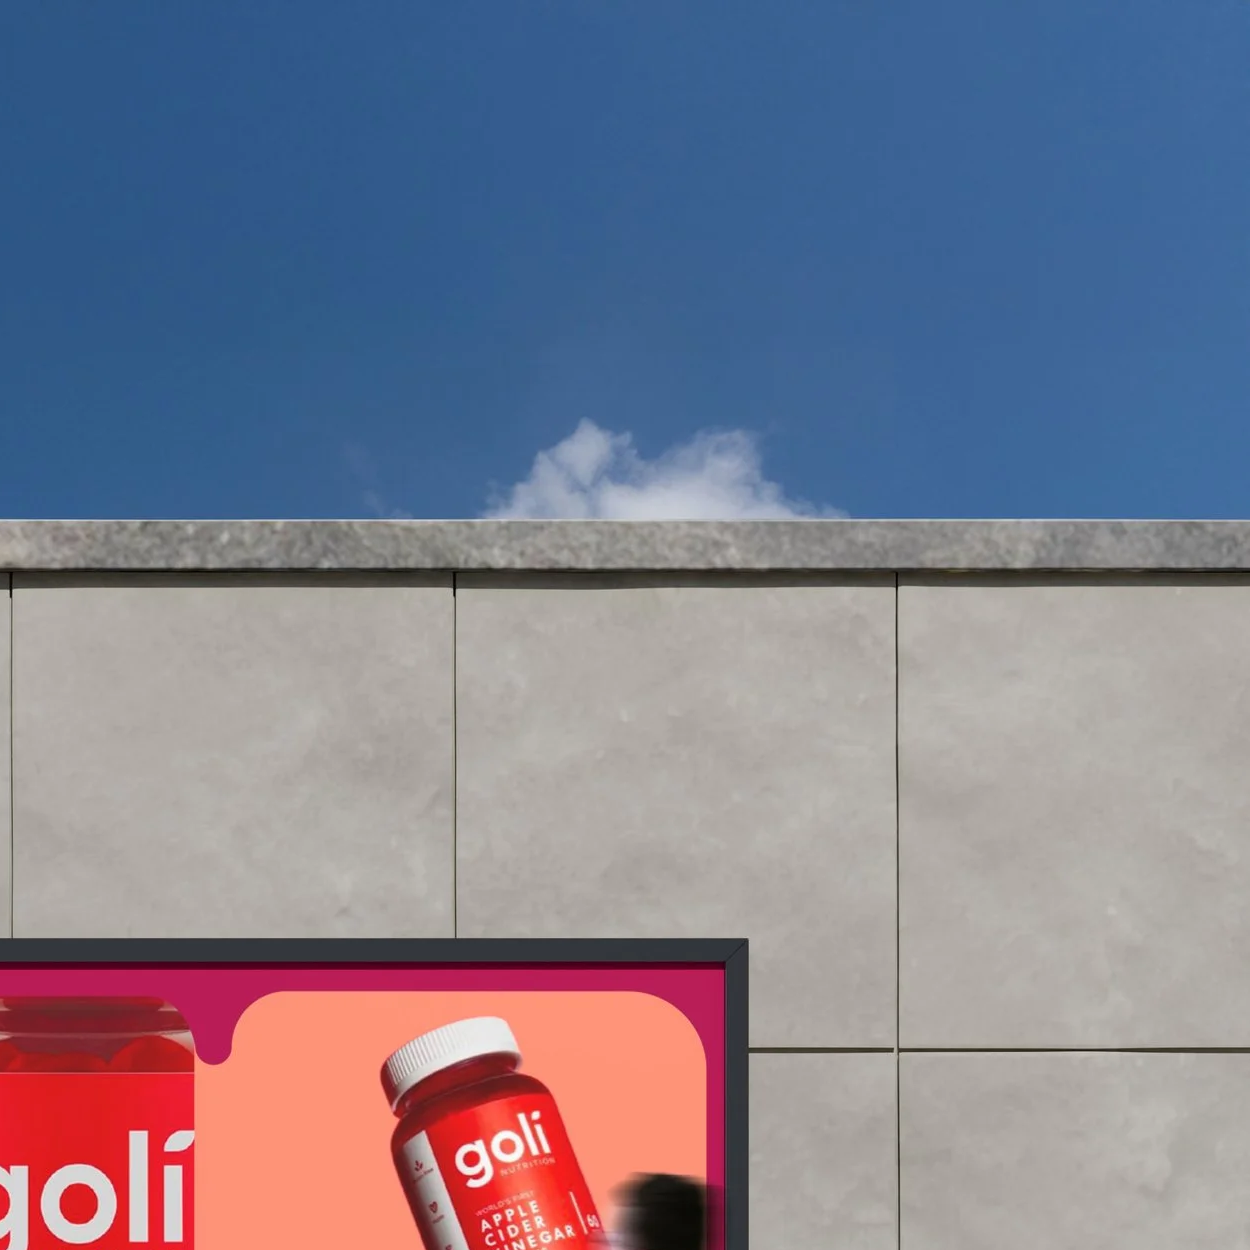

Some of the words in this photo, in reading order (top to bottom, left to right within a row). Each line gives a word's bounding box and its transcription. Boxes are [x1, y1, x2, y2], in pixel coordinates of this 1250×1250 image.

[454, 1110, 552, 1188] goli
[499, 1157, 557, 1177] NUTRITION
[481, 1200, 540, 1233] APPLE
[484, 1215, 546, 1247] CIDER
